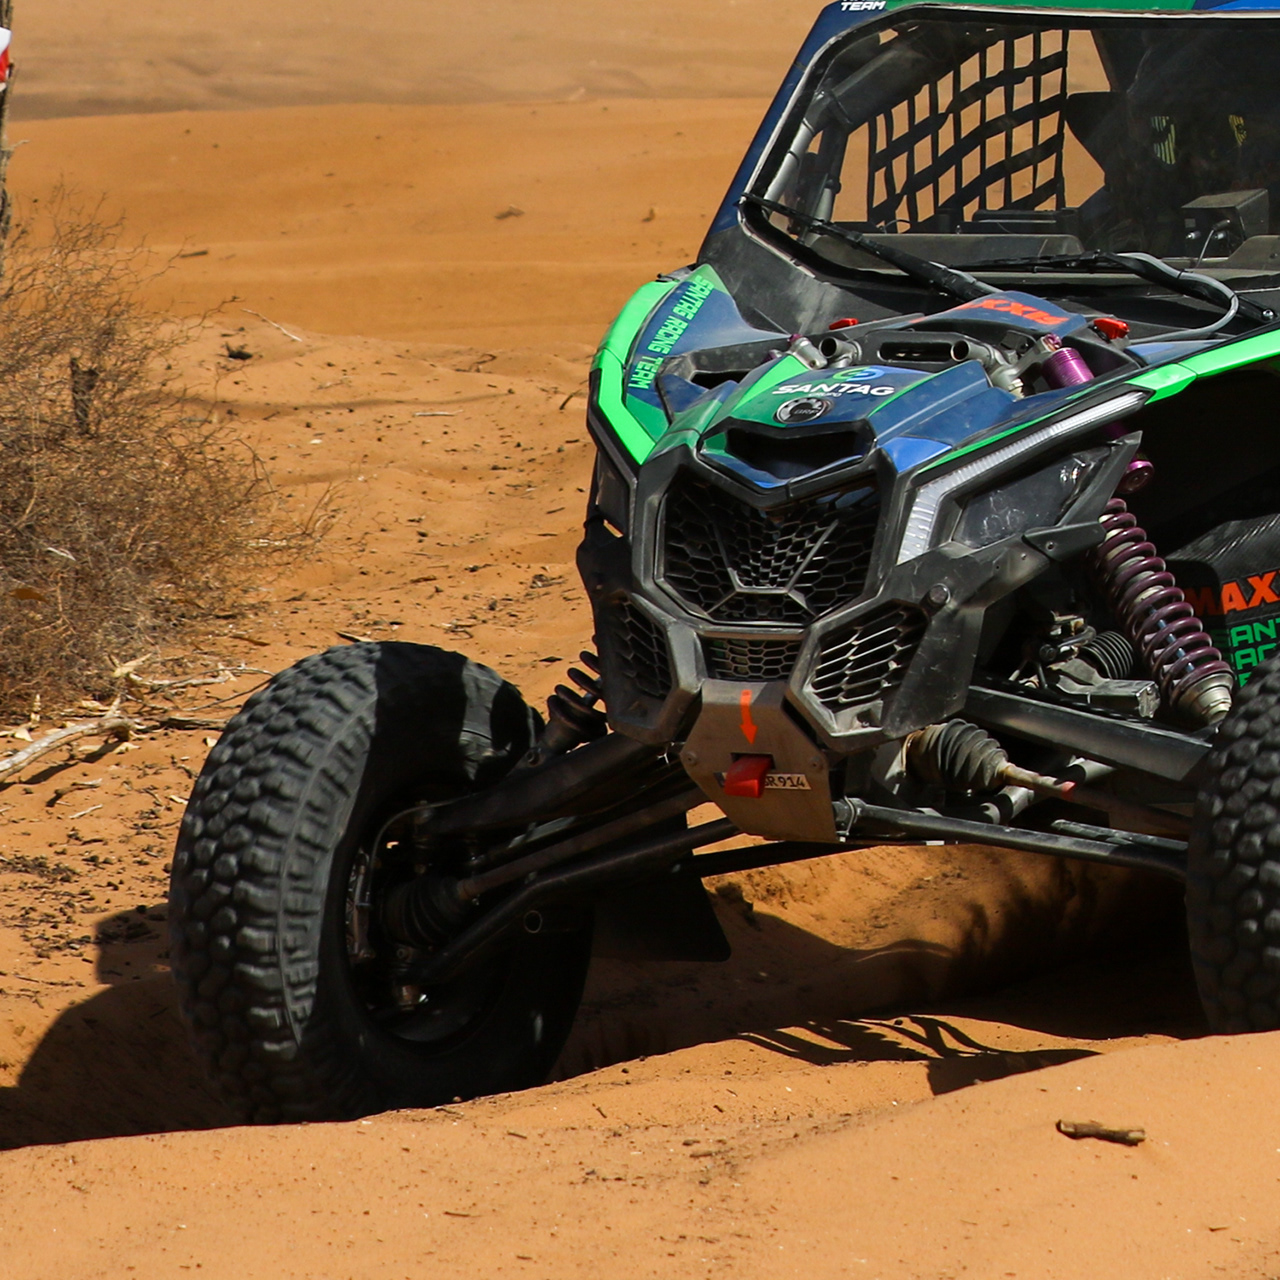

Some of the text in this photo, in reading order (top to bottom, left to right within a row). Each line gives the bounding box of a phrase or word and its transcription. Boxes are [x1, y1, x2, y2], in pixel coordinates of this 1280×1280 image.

[841, 1, 887, 11] TEAM
[627, 275, 715, 389] SANTAG RACING TEAM
[772, 383, 895, 396] SANTAG
